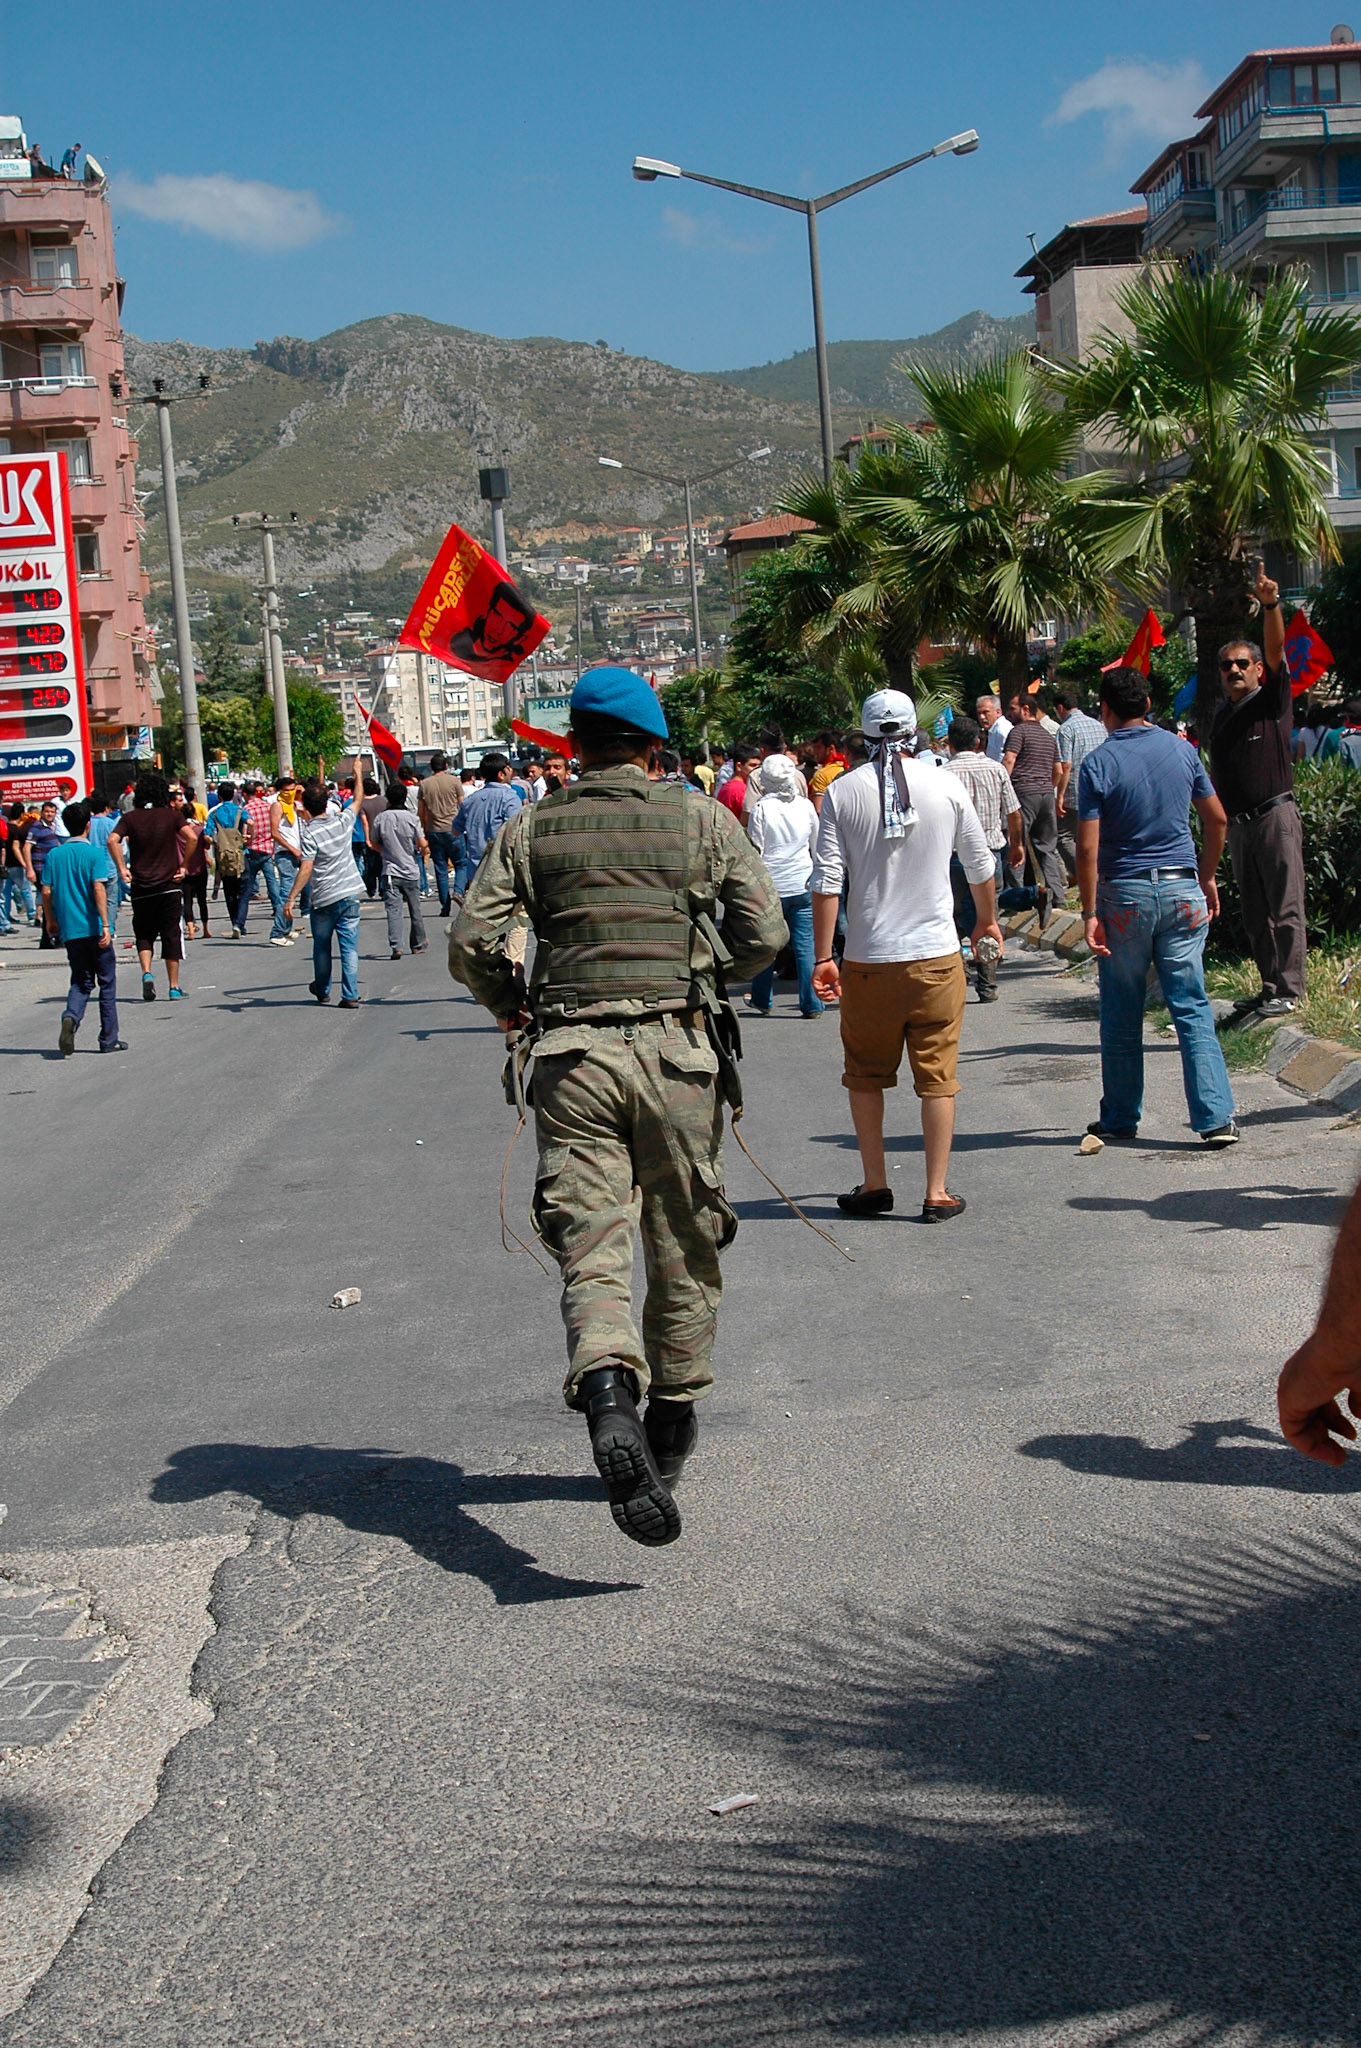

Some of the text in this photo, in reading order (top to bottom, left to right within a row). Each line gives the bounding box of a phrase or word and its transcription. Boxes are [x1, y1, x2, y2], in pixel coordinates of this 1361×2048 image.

[24, 589, 60, 609] 4.13
[28, 651, 65, 671] 4.72
[32, 687, 68, 707] 2.54
[10, 755, 69, 768] akpet gaz
[32, 779, 57, 787] PETROL
